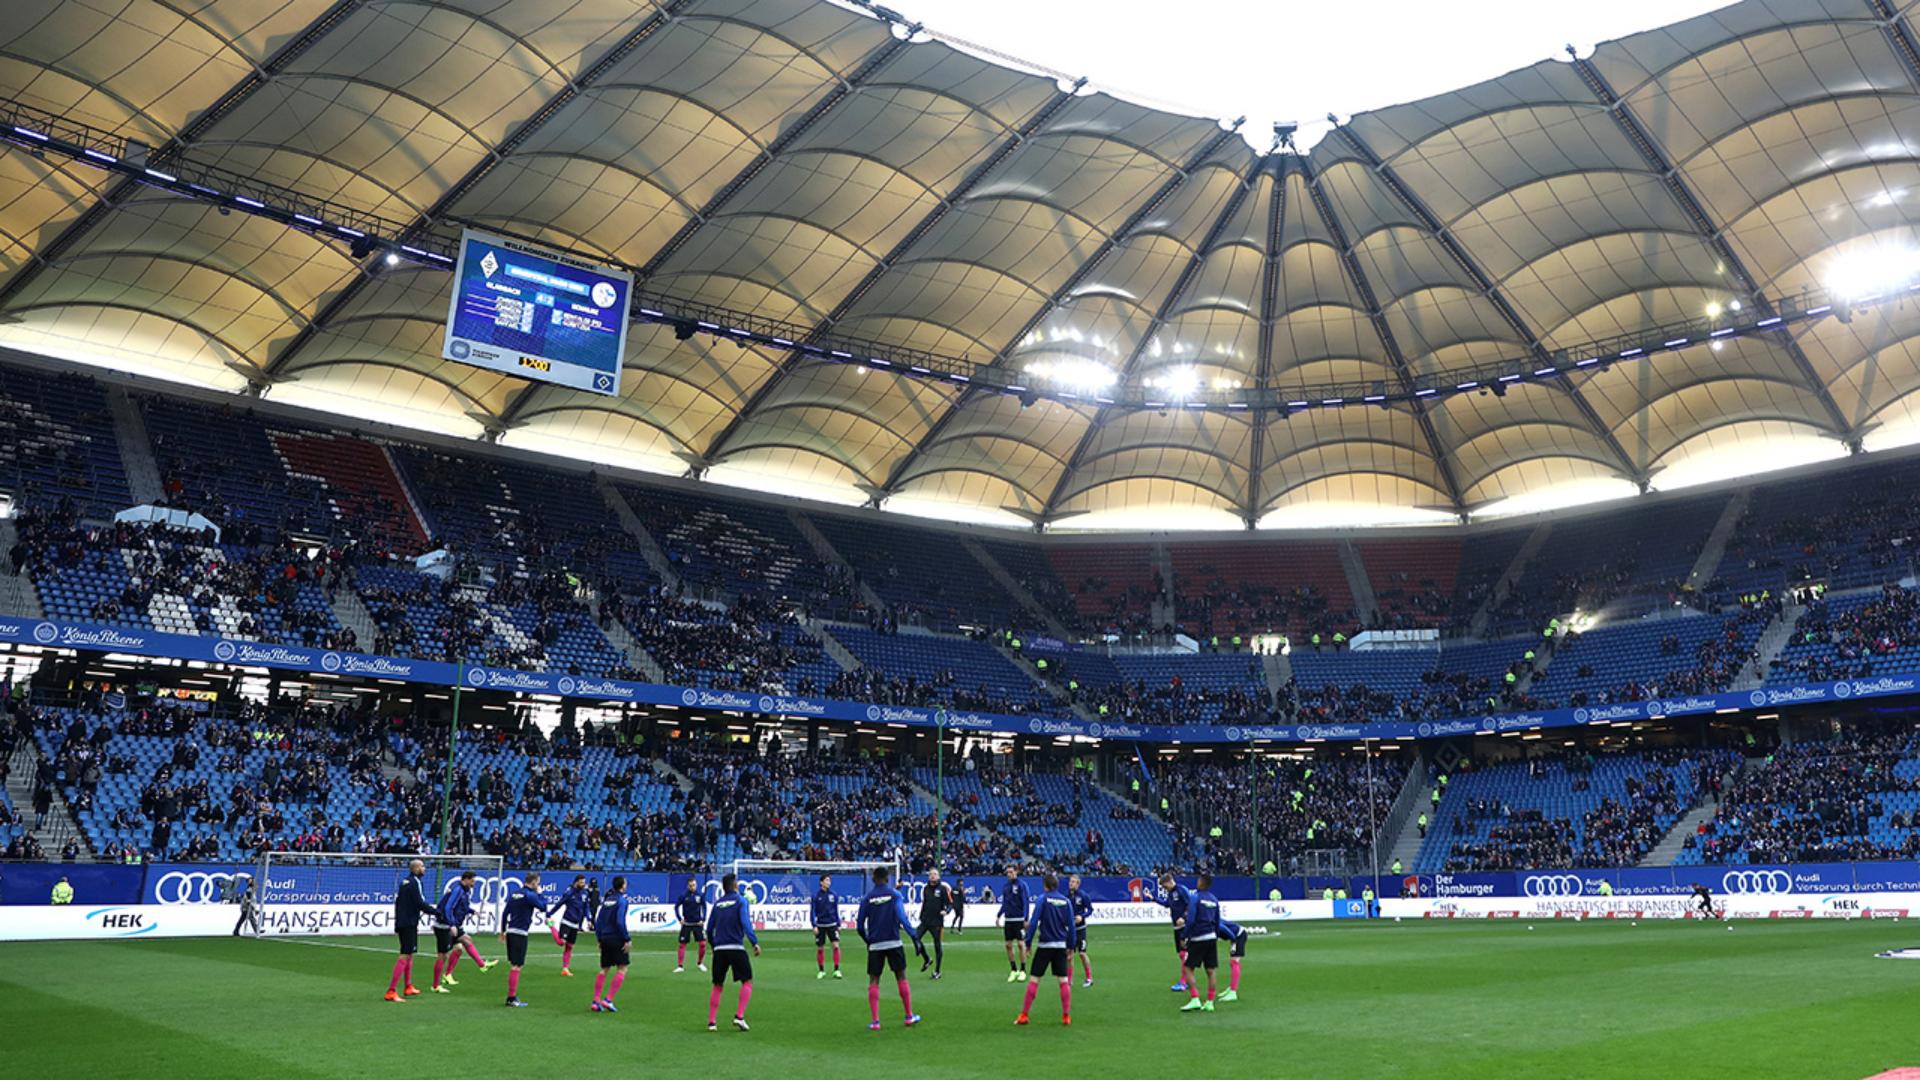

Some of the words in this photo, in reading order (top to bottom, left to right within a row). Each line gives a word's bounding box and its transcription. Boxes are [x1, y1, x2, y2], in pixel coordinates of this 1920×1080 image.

[61, 626, 100, 644] König
[237, 645, 273, 663] König
[1435, 874, 1454, 885] Der
[1795, 874, 1820, 882] Audi
[264, 879, 296, 889] Audi
[771, 884, 793, 894] Audi
[1795, 883, 1850, 892] Vorsprung
[1854, 883, 1884, 891] durch
[1436, 884, 1494, 896] Hamburger
[1633, 886, 1659, 894] durch
[263, 891, 331, 903] Vorsprung
[334, 891, 370, 902] durch
[770, 895, 812, 905] Vorsprun
[1536, 901, 1623, 913] HANSEATISCHE
[1833, 900, 1859, 910] HEK
[102, 914, 143, 928] HEK
[261, 911, 396, 928] HANSEATISCH
[640, 911, 667, 923] HEK
